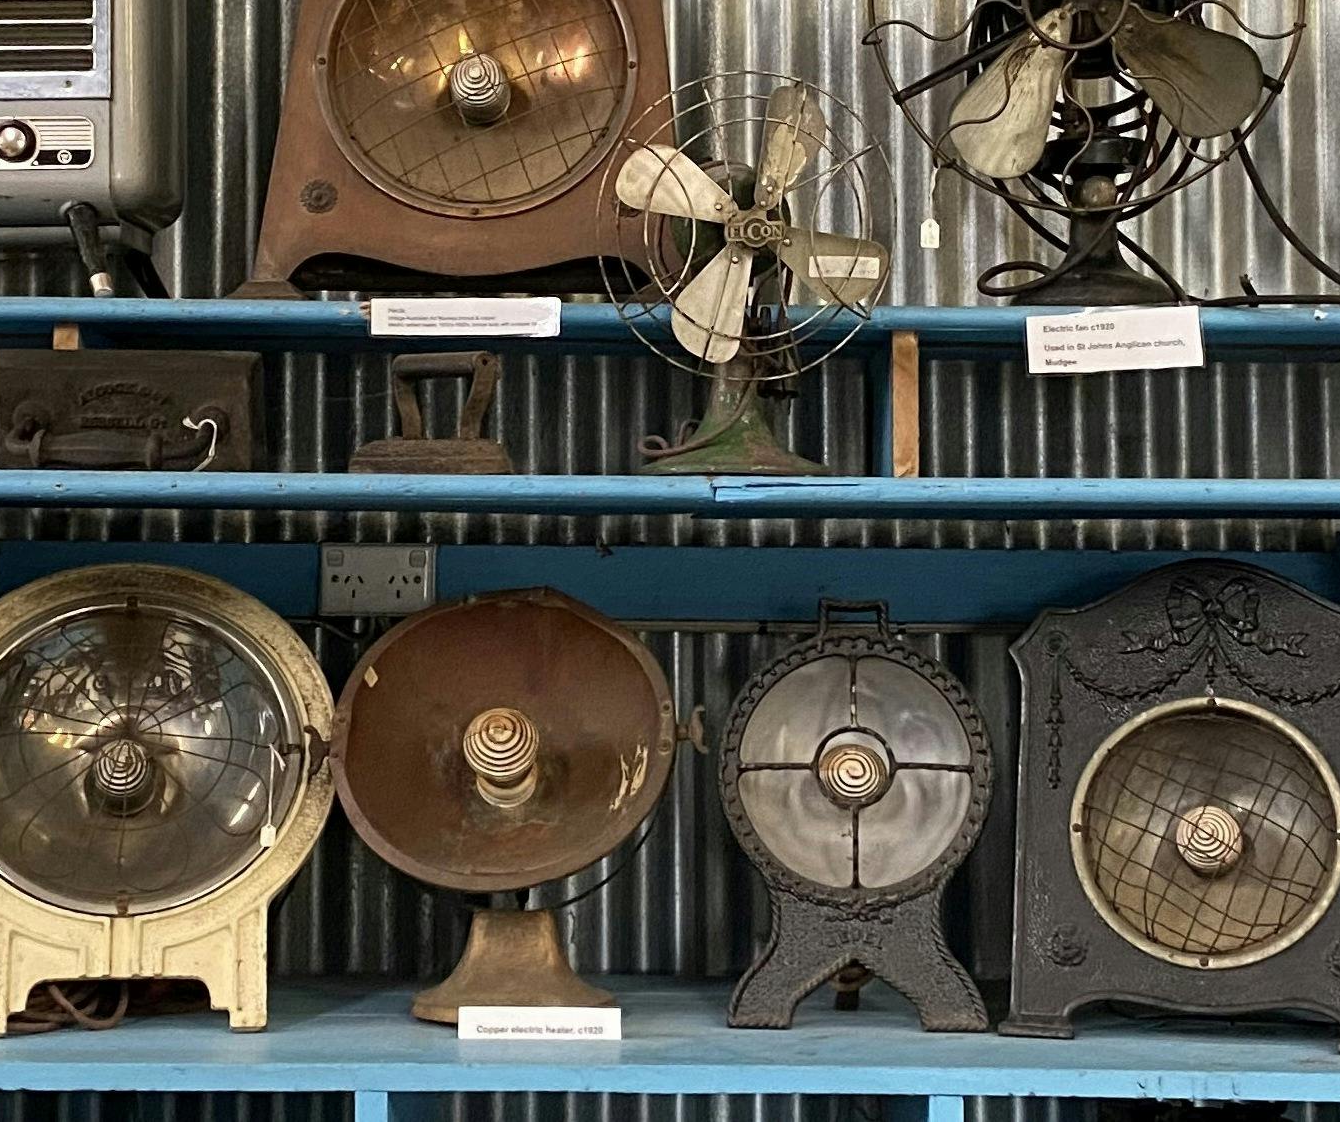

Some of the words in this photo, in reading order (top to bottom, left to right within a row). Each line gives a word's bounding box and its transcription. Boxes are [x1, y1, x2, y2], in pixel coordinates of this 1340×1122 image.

[1043, 325, 1073, 333] Electric
[1044, 344, 1065, 352] Used
[1087, 342, 1113, 351] Johns
[1114, 341, 1151, 350] Anglican
[1045, 359, 1077, 367] Mudgee
[476, 1025, 508, 1035] Copper
[511, 1025, 543, 1034] electric
[545, 1025, 574, 1034] heater,
